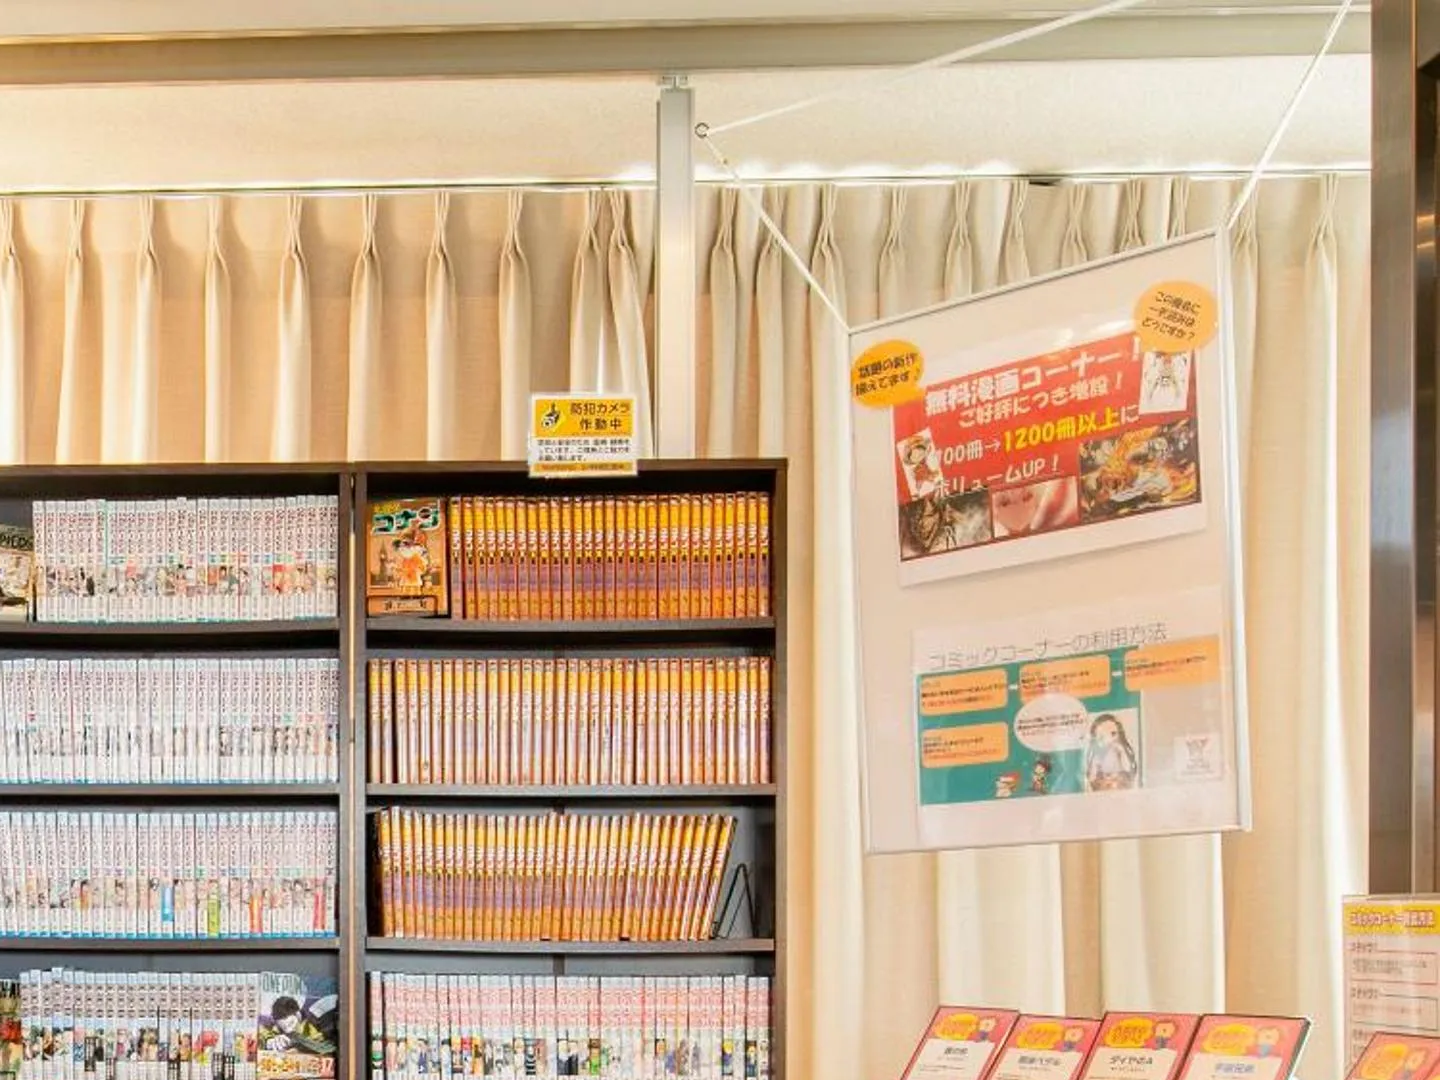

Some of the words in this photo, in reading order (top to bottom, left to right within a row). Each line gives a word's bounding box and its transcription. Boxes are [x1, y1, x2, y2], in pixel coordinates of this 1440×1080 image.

[570, 402, 631, 416] 防犯カメラ
[579, 417, 622, 431] 作動中
[929, 623, 1168, 671] コミックコーナーの利用方法
